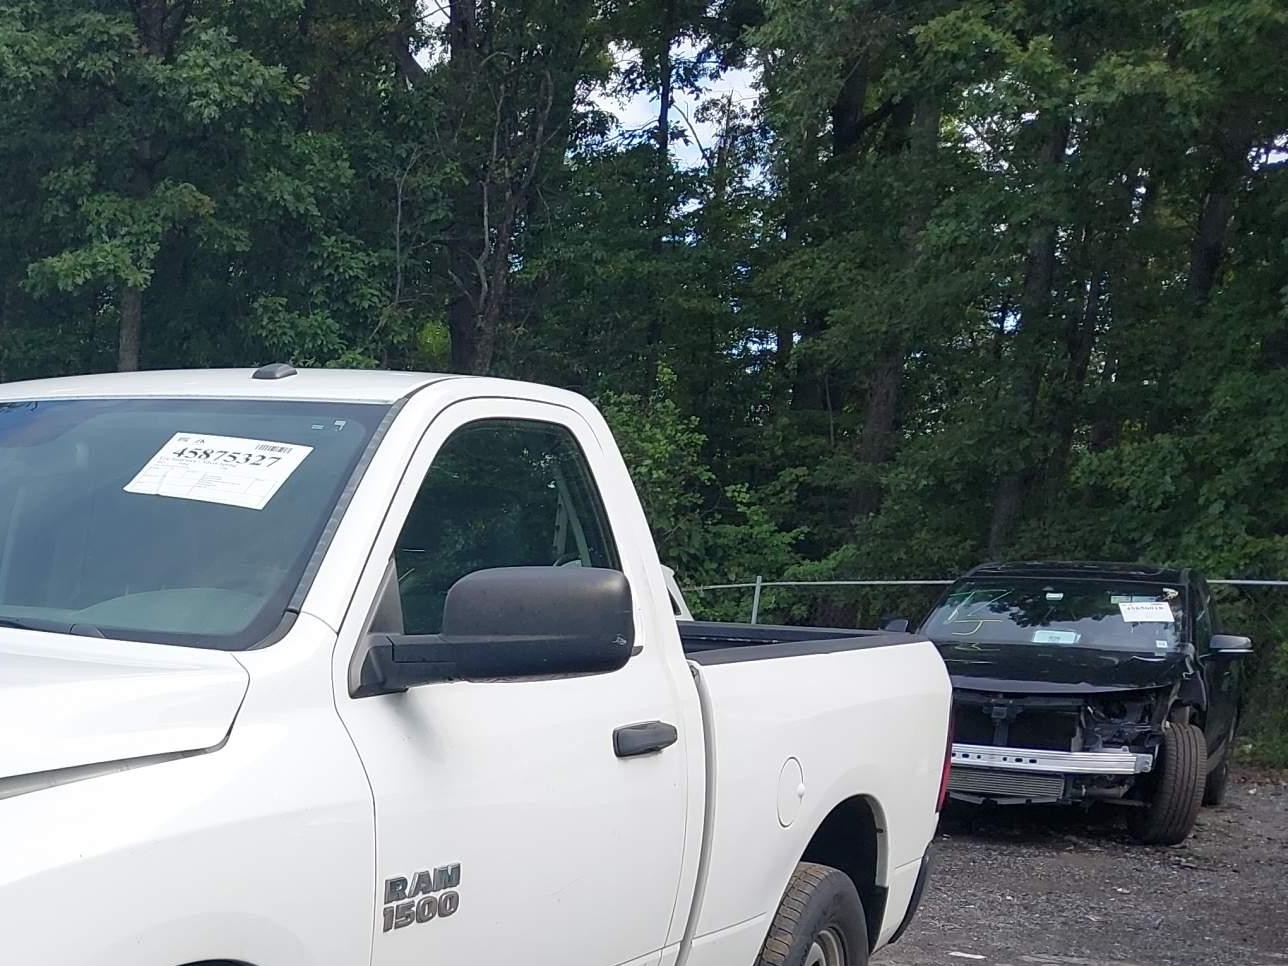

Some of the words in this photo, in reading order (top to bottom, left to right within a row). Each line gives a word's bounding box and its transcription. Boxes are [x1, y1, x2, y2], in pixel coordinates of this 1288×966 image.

[172, 446, 282, 467] 45875327
[384, 863, 461, 904] RAM
[383, 891, 460, 933] 1500
